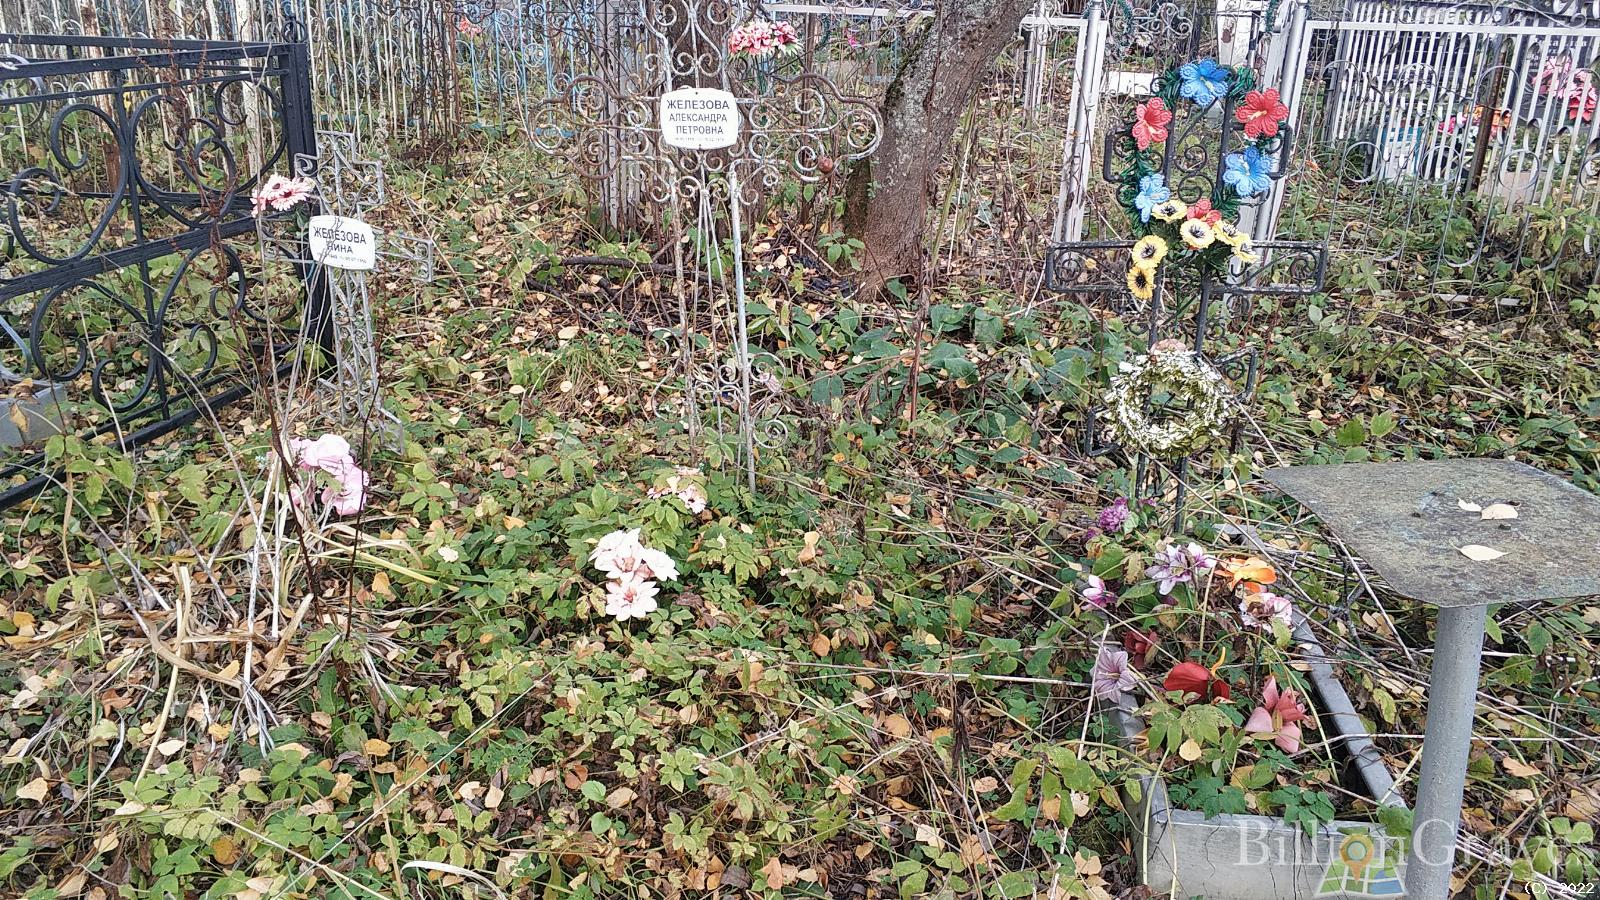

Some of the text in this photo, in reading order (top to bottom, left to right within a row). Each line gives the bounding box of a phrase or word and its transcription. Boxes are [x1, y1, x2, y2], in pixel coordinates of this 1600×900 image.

[666, 99, 730, 110] ЖЕЛЕЗОВА
[669, 113, 728, 124] АЛЕКСАНДРА
[676, 125, 724, 135] ПЕТРОВНА
[313, 226, 367, 245] ЖЕЛЕЗОВА
[327, 243, 354, 254] НИНА
